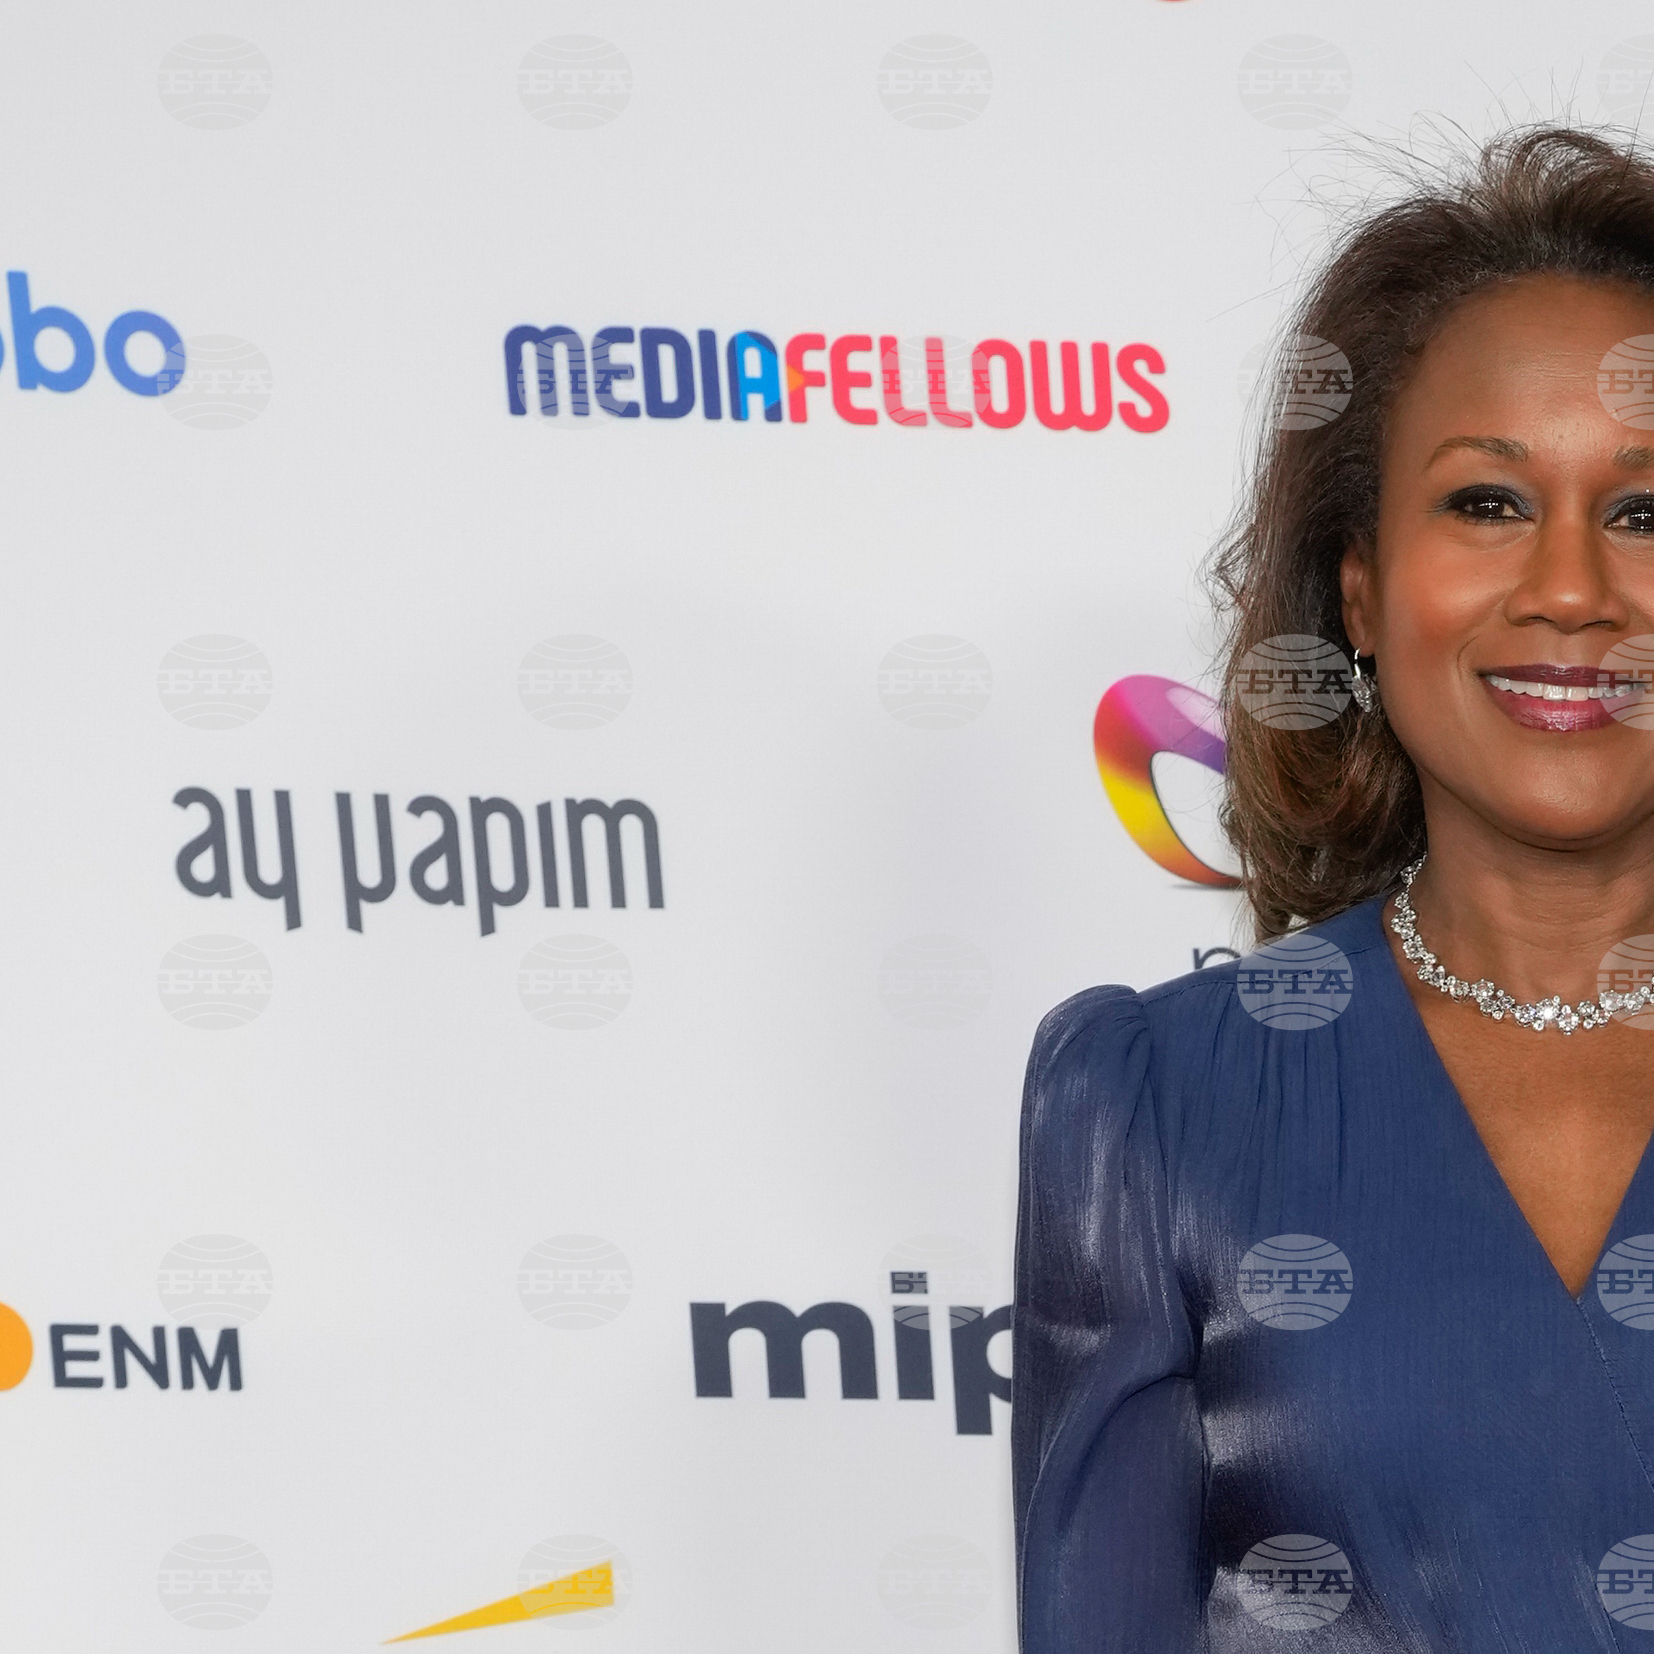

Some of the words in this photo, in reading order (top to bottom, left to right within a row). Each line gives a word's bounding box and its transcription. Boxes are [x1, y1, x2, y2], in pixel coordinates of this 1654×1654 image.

[0, 269, 187, 398] bo
[502, 323, 1171, 435] MEDIAFELLOWS
[48, 1322, 244, 1393] ENM
